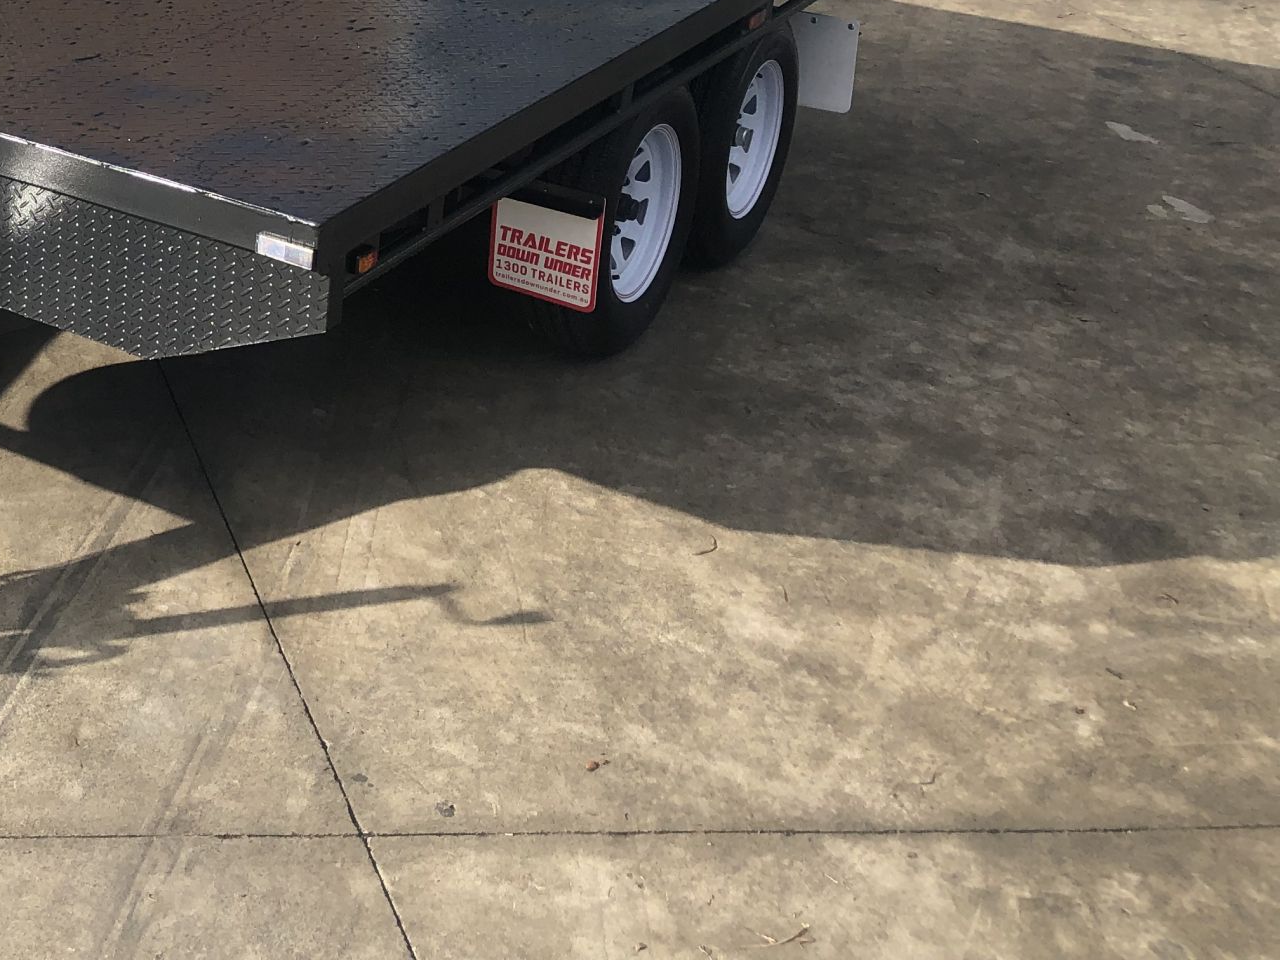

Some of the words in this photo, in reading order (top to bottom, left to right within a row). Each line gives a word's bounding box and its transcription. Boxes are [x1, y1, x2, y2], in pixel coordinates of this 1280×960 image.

[497, 243, 540, 266] DOWN
[544, 256, 592, 281] UNDER
[500, 225, 594, 265] TRAILERS
[495, 258, 528, 276] 1300
[531, 268, 590, 295] TRAILERS
[495, 271, 589, 304] trailersdownunder.com.au
